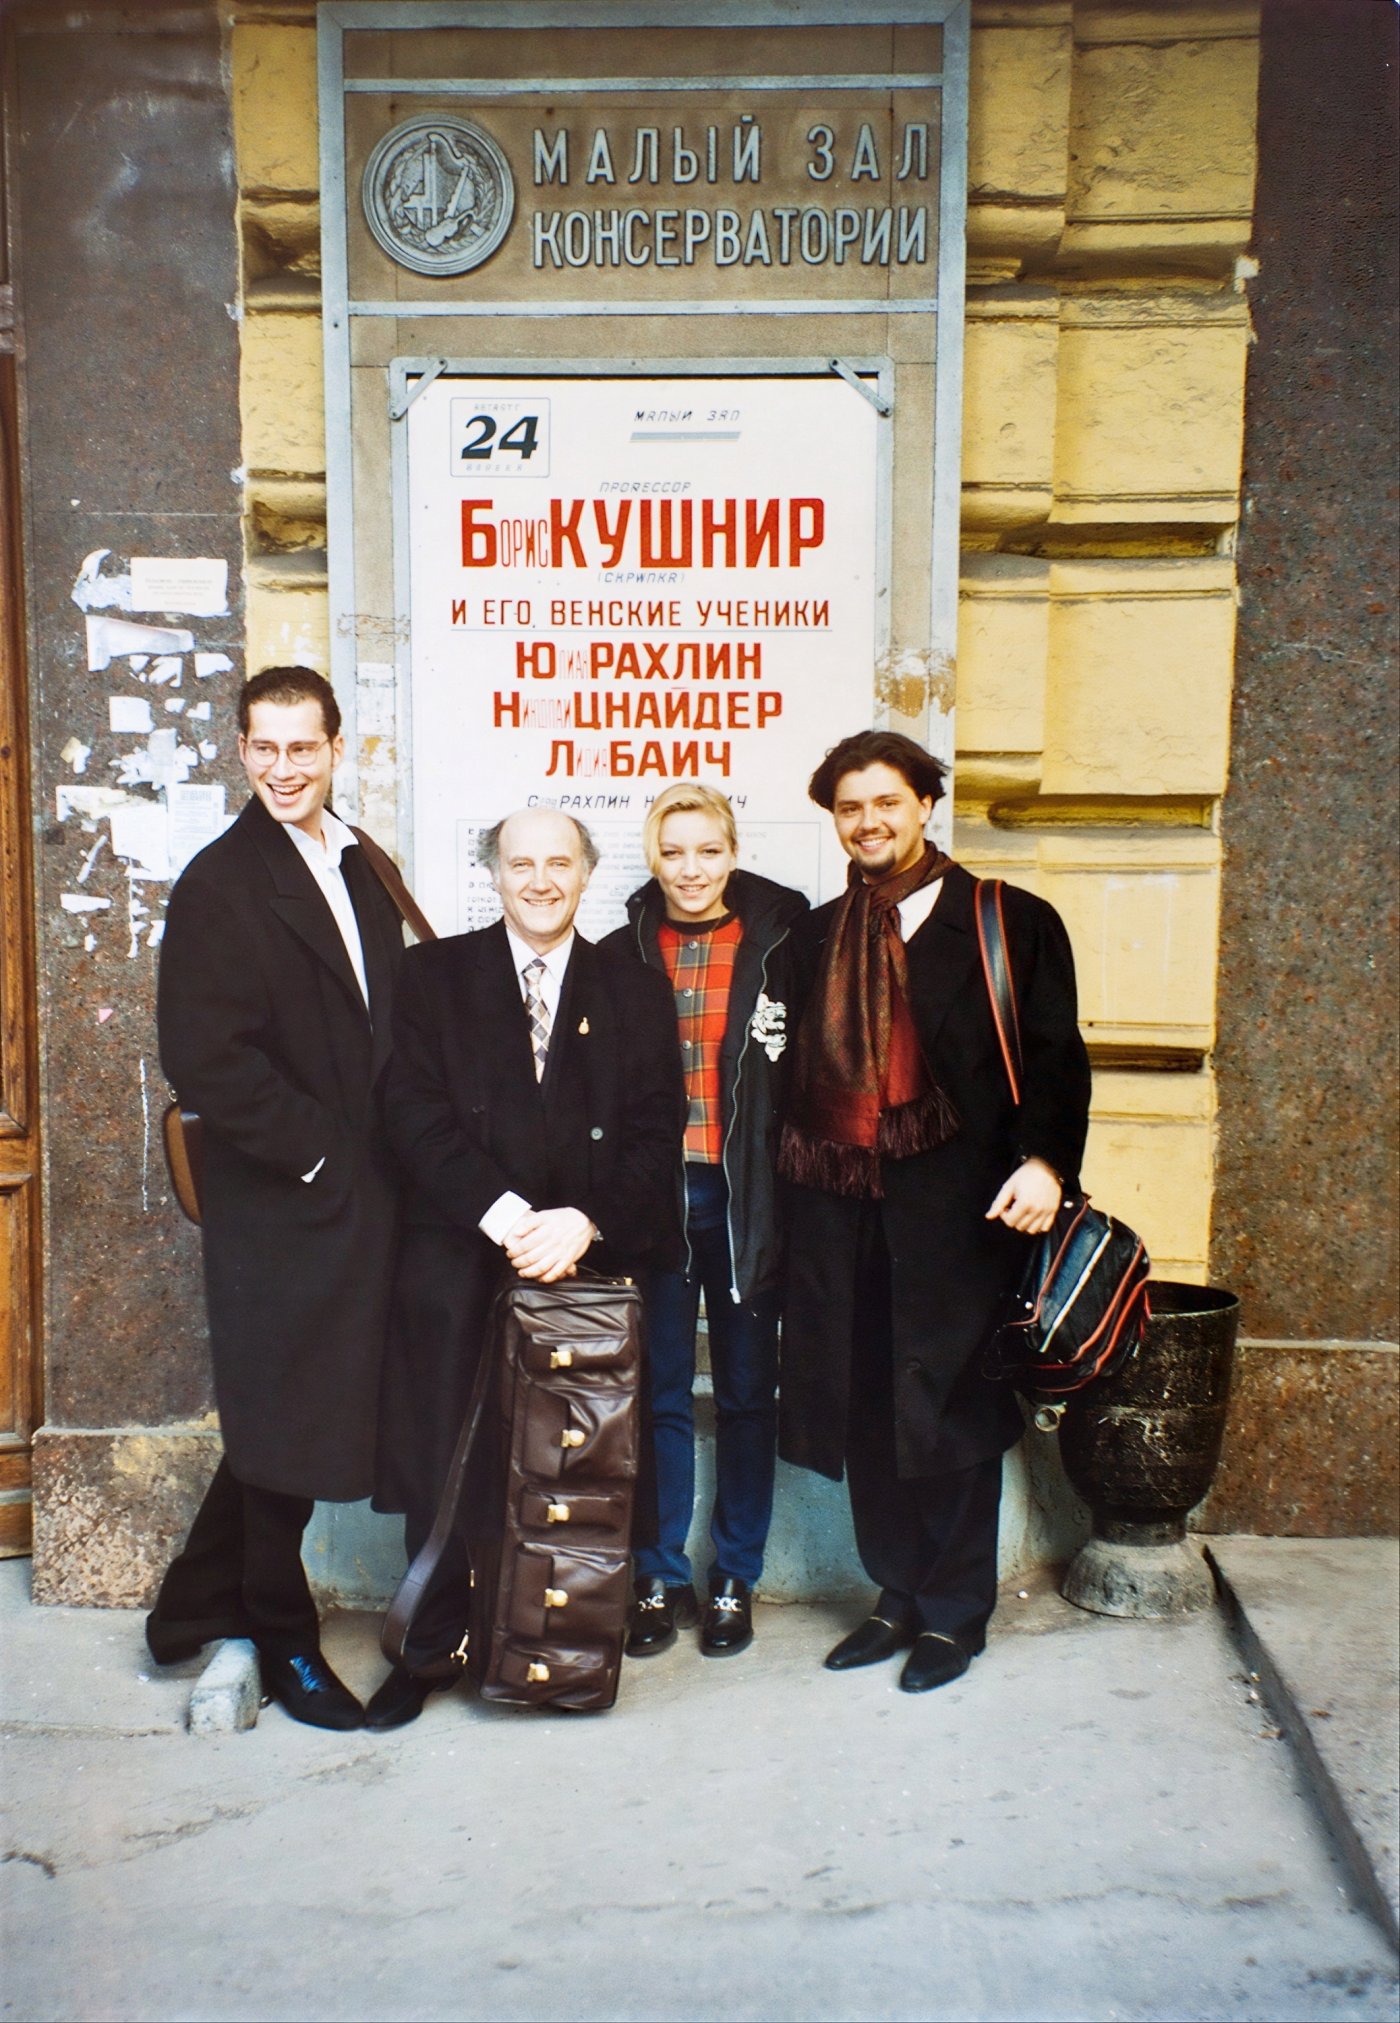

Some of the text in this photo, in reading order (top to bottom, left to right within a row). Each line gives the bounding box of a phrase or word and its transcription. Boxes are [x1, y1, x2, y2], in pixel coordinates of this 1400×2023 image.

[532, 114, 929, 184] МАЛЫЙ ЗАЛ
[532, 206, 928, 268] КОНСЕРВАТОРИИ
[461, 415, 539, 460] 24
[550, 498, 825, 569] КУШНИР
[452, 600, 466, 625] И
[551, 600, 682, 626] ВЕНСКИЕ
[697, 600, 829, 626] УЧЕНИКИ
[590, 642, 762, 680] РАХЛИН
[574, 686, 782, 730] ЦНАЙДЕР
[610, 740, 731, 778] БАИЧ
